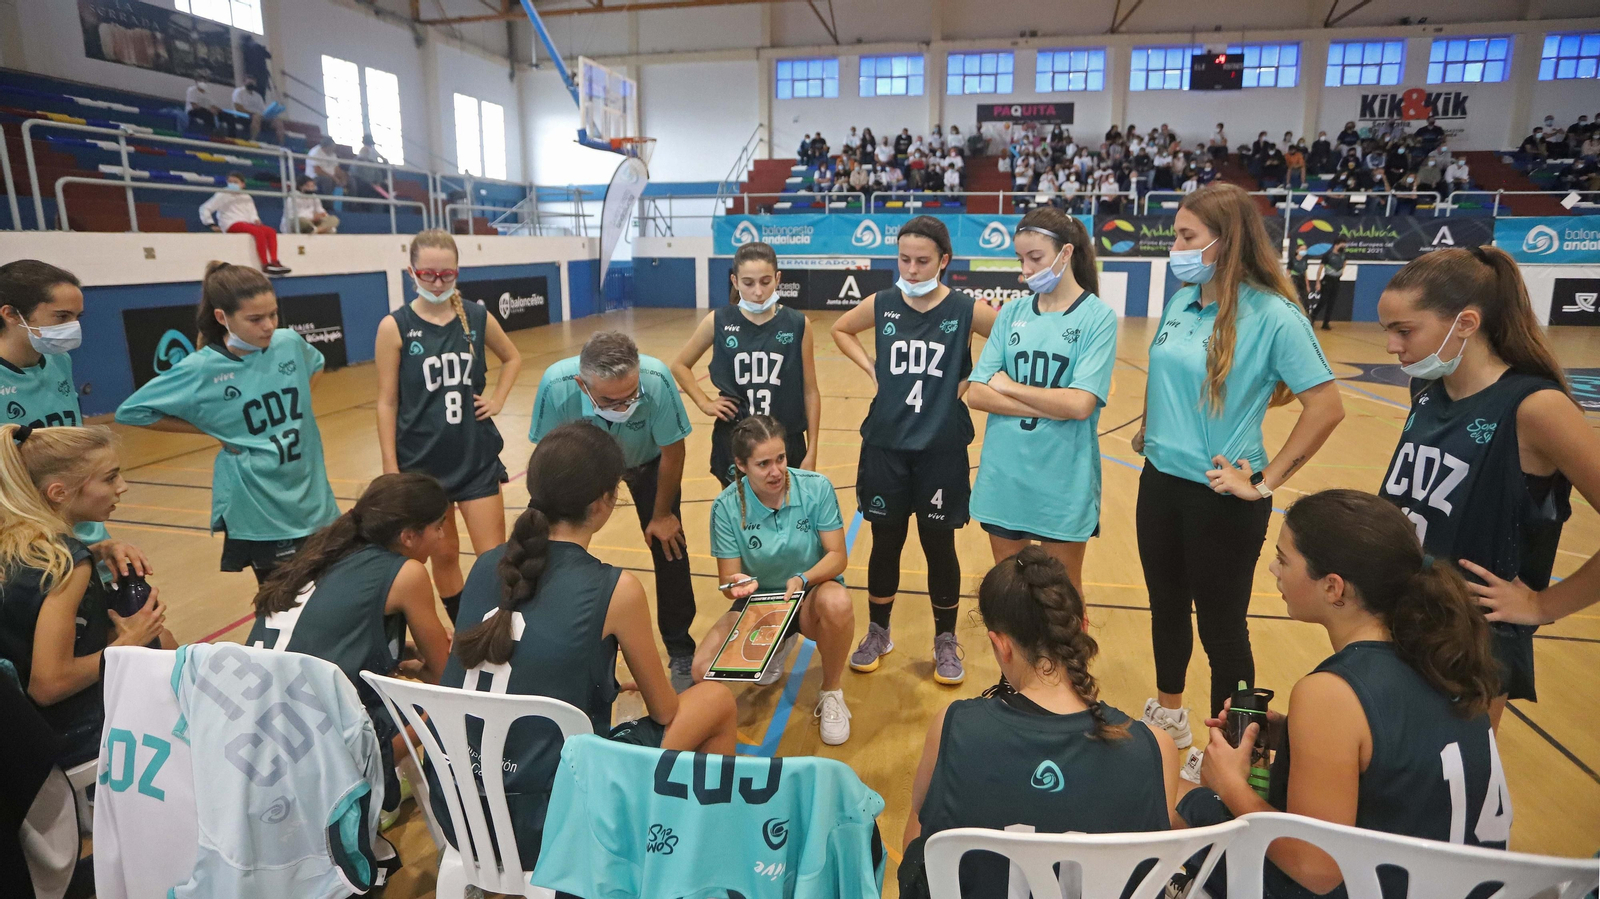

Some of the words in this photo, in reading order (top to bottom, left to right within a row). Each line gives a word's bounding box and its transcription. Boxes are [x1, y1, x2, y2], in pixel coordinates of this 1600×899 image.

[993, 104, 1056, 118] PAQUITA
[762, 225, 814, 235] baloncesto
[1140, 223, 1176, 237] Andal
[776, 282, 800, 290] ncesto
[955, 286, 1030, 301] osotras
[724, 323, 741, 332] vive
[883, 310, 901, 320] vive
[422, 351, 474, 392] CDZ
[733, 351, 785, 386] CDZ
[889, 339, 946, 378] CDZ
[1014, 350, 1070, 389] CDZ
[0, 385, 17, 395] ive
[746, 388, 771, 416] 13
[905, 380, 923, 413] 4
[242, 387, 303, 436] CDZ
[444, 391, 462, 424] 8
[269, 428, 302, 465] 12
[1385, 442, 1470, 517] CDZ
[930, 488, 943, 510] 4
[743, 522, 761, 531] vive
[927, 512, 945, 520] vive
[99, 727, 172, 802] DZ
[1439, 726, 1513, 851] 14
